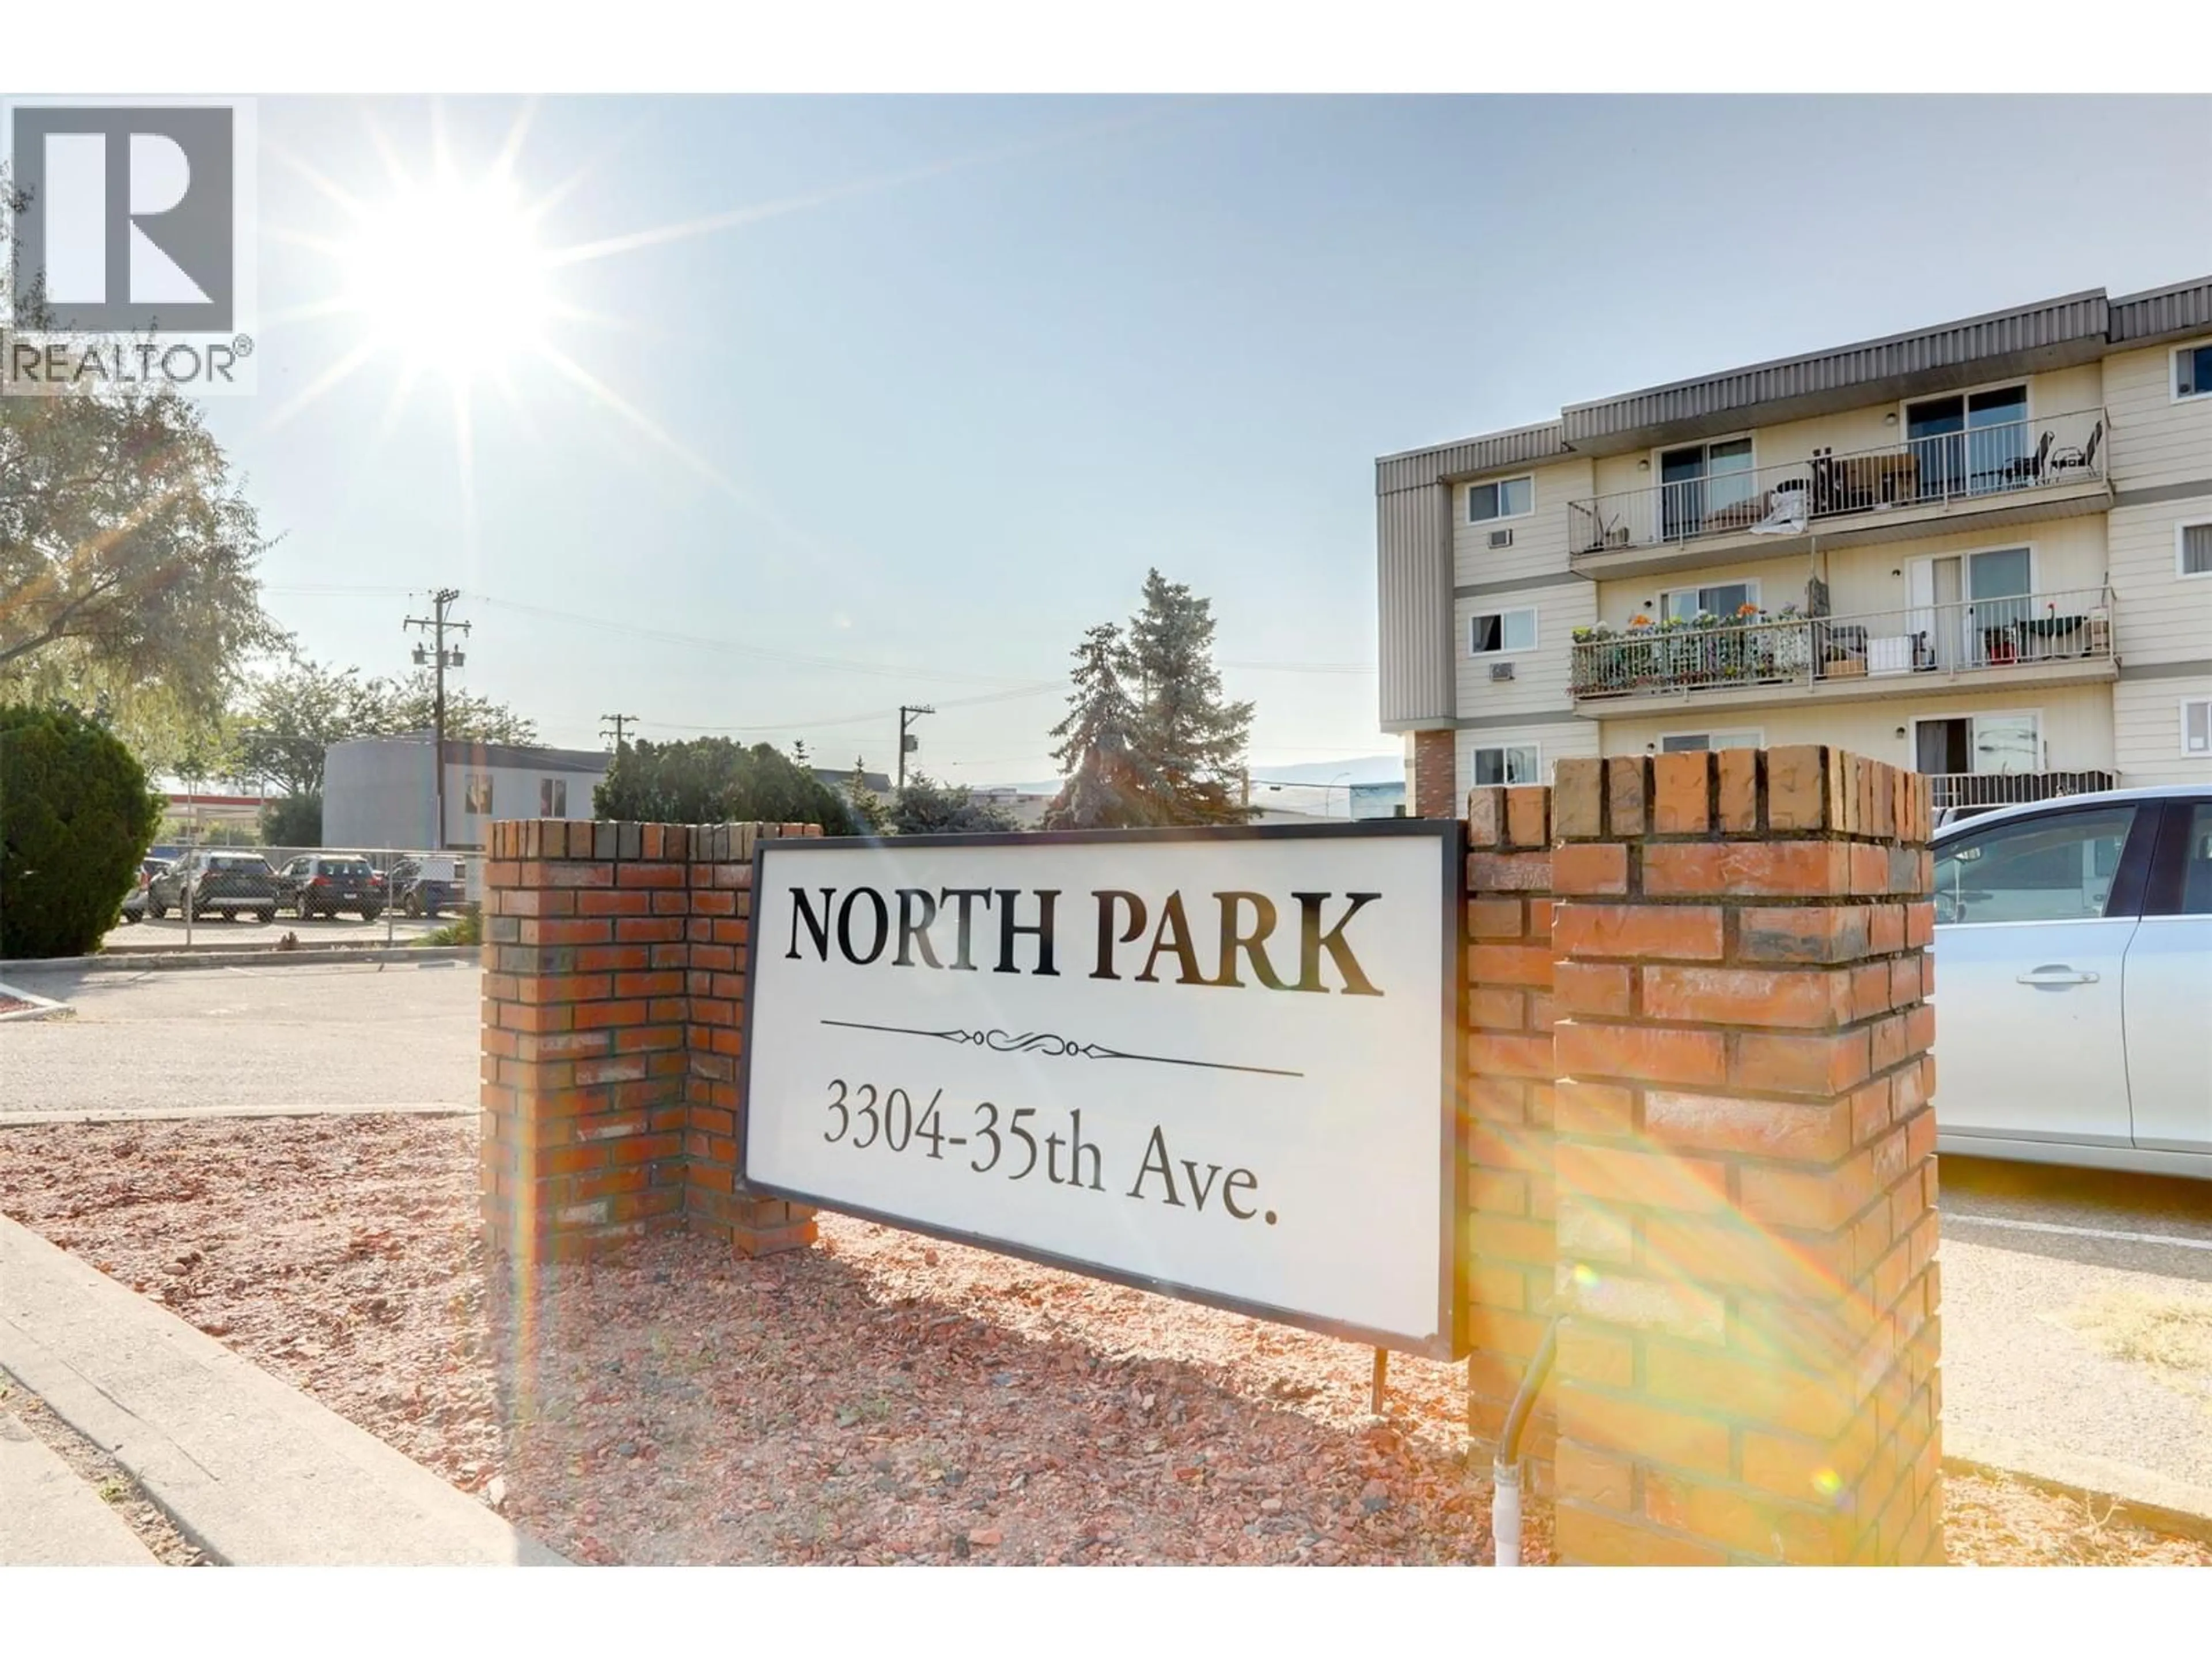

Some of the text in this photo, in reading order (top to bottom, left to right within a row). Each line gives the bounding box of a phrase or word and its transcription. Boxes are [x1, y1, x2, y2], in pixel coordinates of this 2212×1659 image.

[784, 886, 1385, 997] NORTH PARK
[823, 1079, 1278, 1226] 3304-35th Ave.
